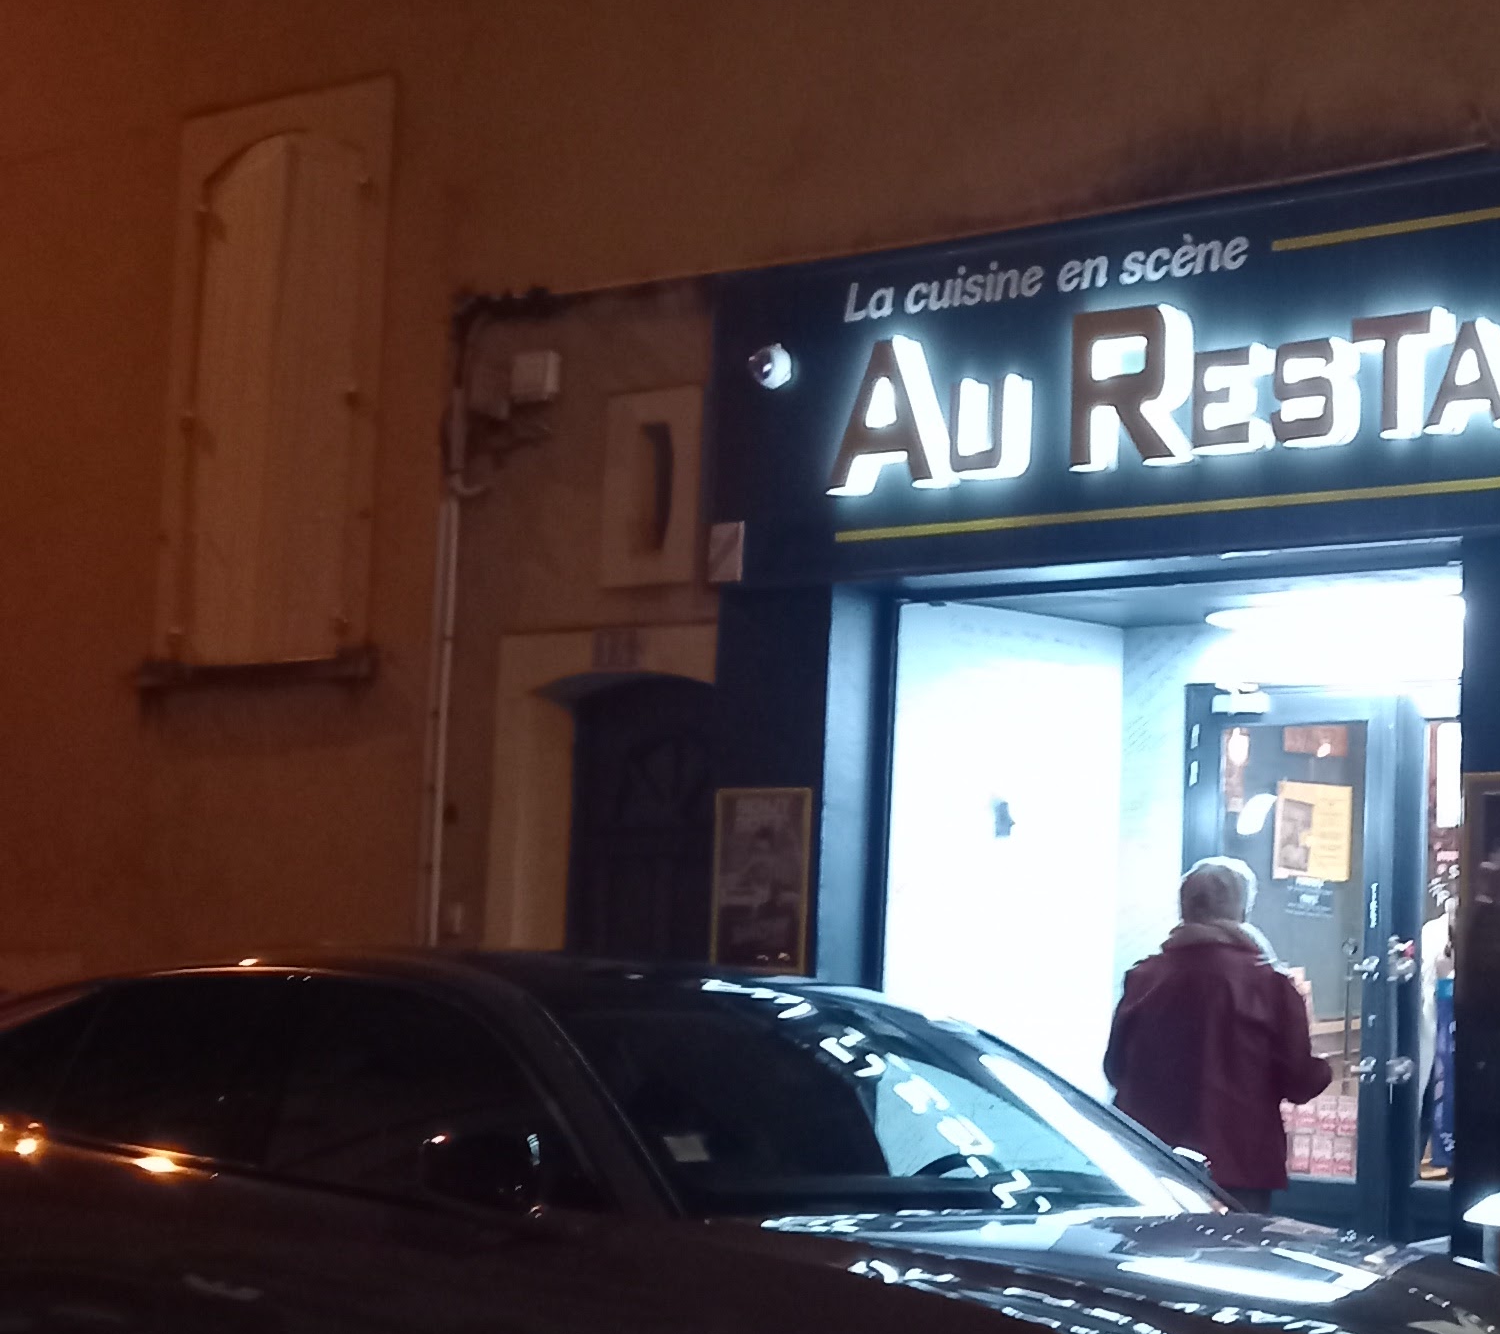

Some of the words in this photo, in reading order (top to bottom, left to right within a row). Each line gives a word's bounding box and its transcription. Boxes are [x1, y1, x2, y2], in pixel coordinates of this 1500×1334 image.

[842, 279, 894, 323] La
[904, 260, 1044, 315] cuisine
[1057, 252, 1110, 292] en
[1120, 233, 1250, 285] scène
